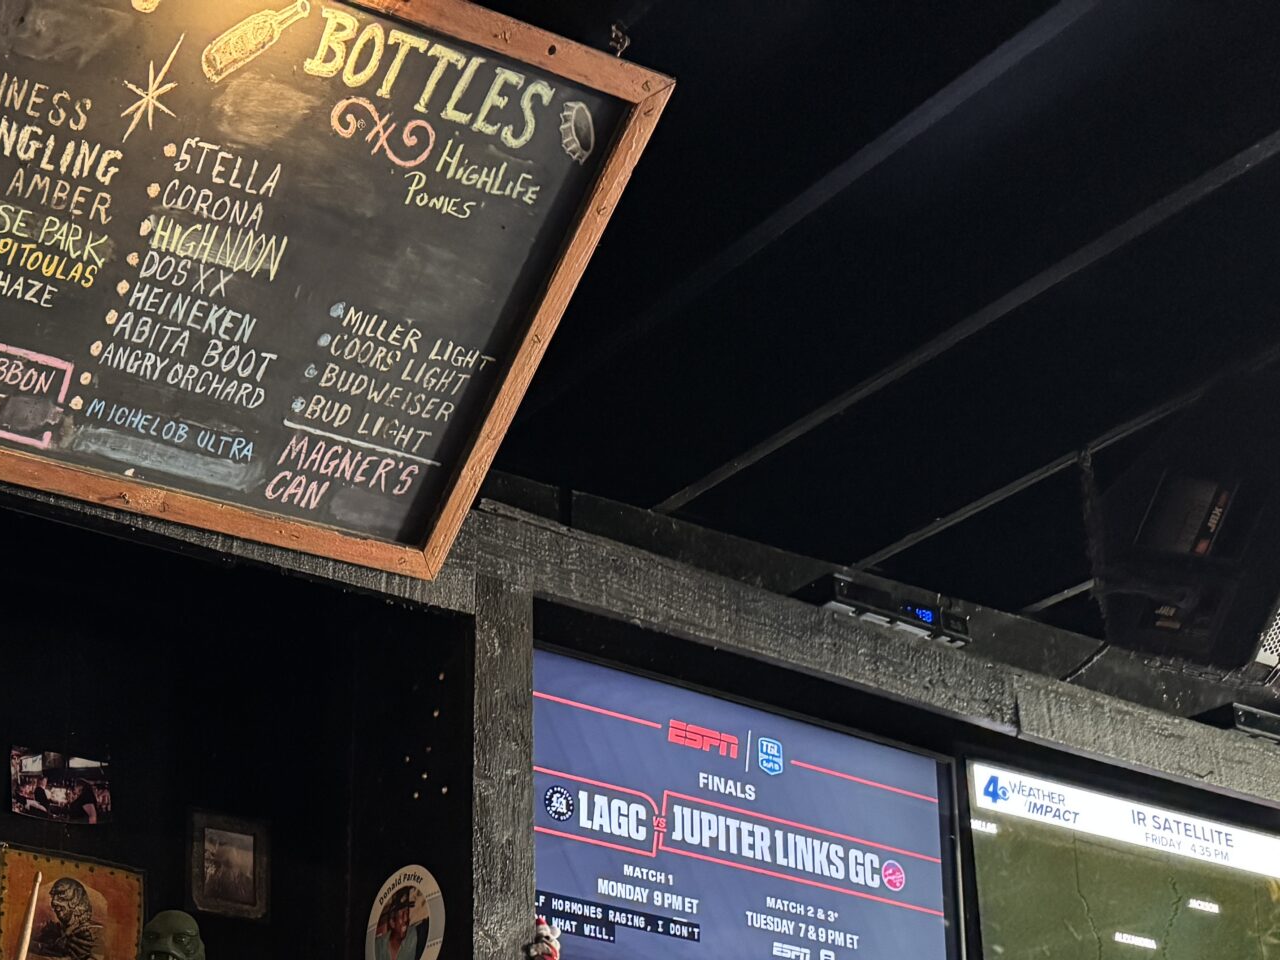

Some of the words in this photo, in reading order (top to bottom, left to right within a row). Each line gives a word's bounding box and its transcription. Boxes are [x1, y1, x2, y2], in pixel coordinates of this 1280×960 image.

[303, 6, 558, 150] BOTTLES
[174, 138, 283, 198] STELLA
[7, 168, 113, 225] AMBER
[161, 179, 264, 230] CORONA
[39, 216, 109, 268] PARK
[151, 217, 217, 262] HIGH
[219, 233, 288, 281] NOON
[139, 249, 188, 286] DOS
[193, 267, 234, 298] XX
[128, 282, 257, 344] HEINEKEN
[113, 312, 191, 356] ABITA
[202, 337, 278, 382] BOOT
[342, 307, 422, 355] MILLER
[429, 337, 497, 372] LIGHT
[99, 341, 166, 380] ANGRY
[168, 364, 267, 409] ORCHARD
[330, 334, 400, 374] COORS
[401, 358, 471, 398] LIGHT
[318, 363, 456, 423] BUDWEISER
[85, 397, 189, 444] MICHELOB
[197, 430, 255, 463] ULTRA
[304, 394, 351, 428] BUD
[357, 414, 433, 456] LIGHT
[264, 470, 331, 511] CAN
[277, 434, 420, 496] MAGNER'S
[667, 719, 739, 759] ESPN
[698, 772, 757, 801] FINALS
[983, 775, 999, 803] 4
[1008, 780, 1066, 806] WEATHER
[1026, 801, 1080, 824] IMPACT
[1131, 809, 1147, 827] IR
[1151, 812, 1235, 848] SATELLITE
[578, 790, 647, 841] LAGC
[671, 804, 772, 864] JUPITER
[774, 828, 845, 881] LINKS
[848, 848, 880, 888] GC
[1145, 833, 1182, 851] FRIDAY
[1214, 847, 1230, 861] PM
[379, 875, 402, 906] Donald
[403, 873, 423, 884] Parker
[597, 878, 649, 904] MONDAY
[653, 890, 663, 906] 9
[664, 893, 683, 911] PM
[684, 898, 700, 914] ET
[623, 864, 665, 884] MATCH
[667, 874, 674, 885] 1
[552, 897, 603, 919] HORMONES
[608, 910, 652, 932] RAGING,
[670, 923, 700, 940] DON'T
[552, 917, 577, 932] WHAT
[583, 924, 615, 941] WILL.
[745, 911, 795, 936] TUESDAY
[798, 922, 806, 938] 7
[818, 927, 826, 943] 9
[827, 929, 845, 947] PM
[846, 933, 860, 950] ET
[766, 896, 805, 915] MATCH
[807, 906, 815, 917] 2
